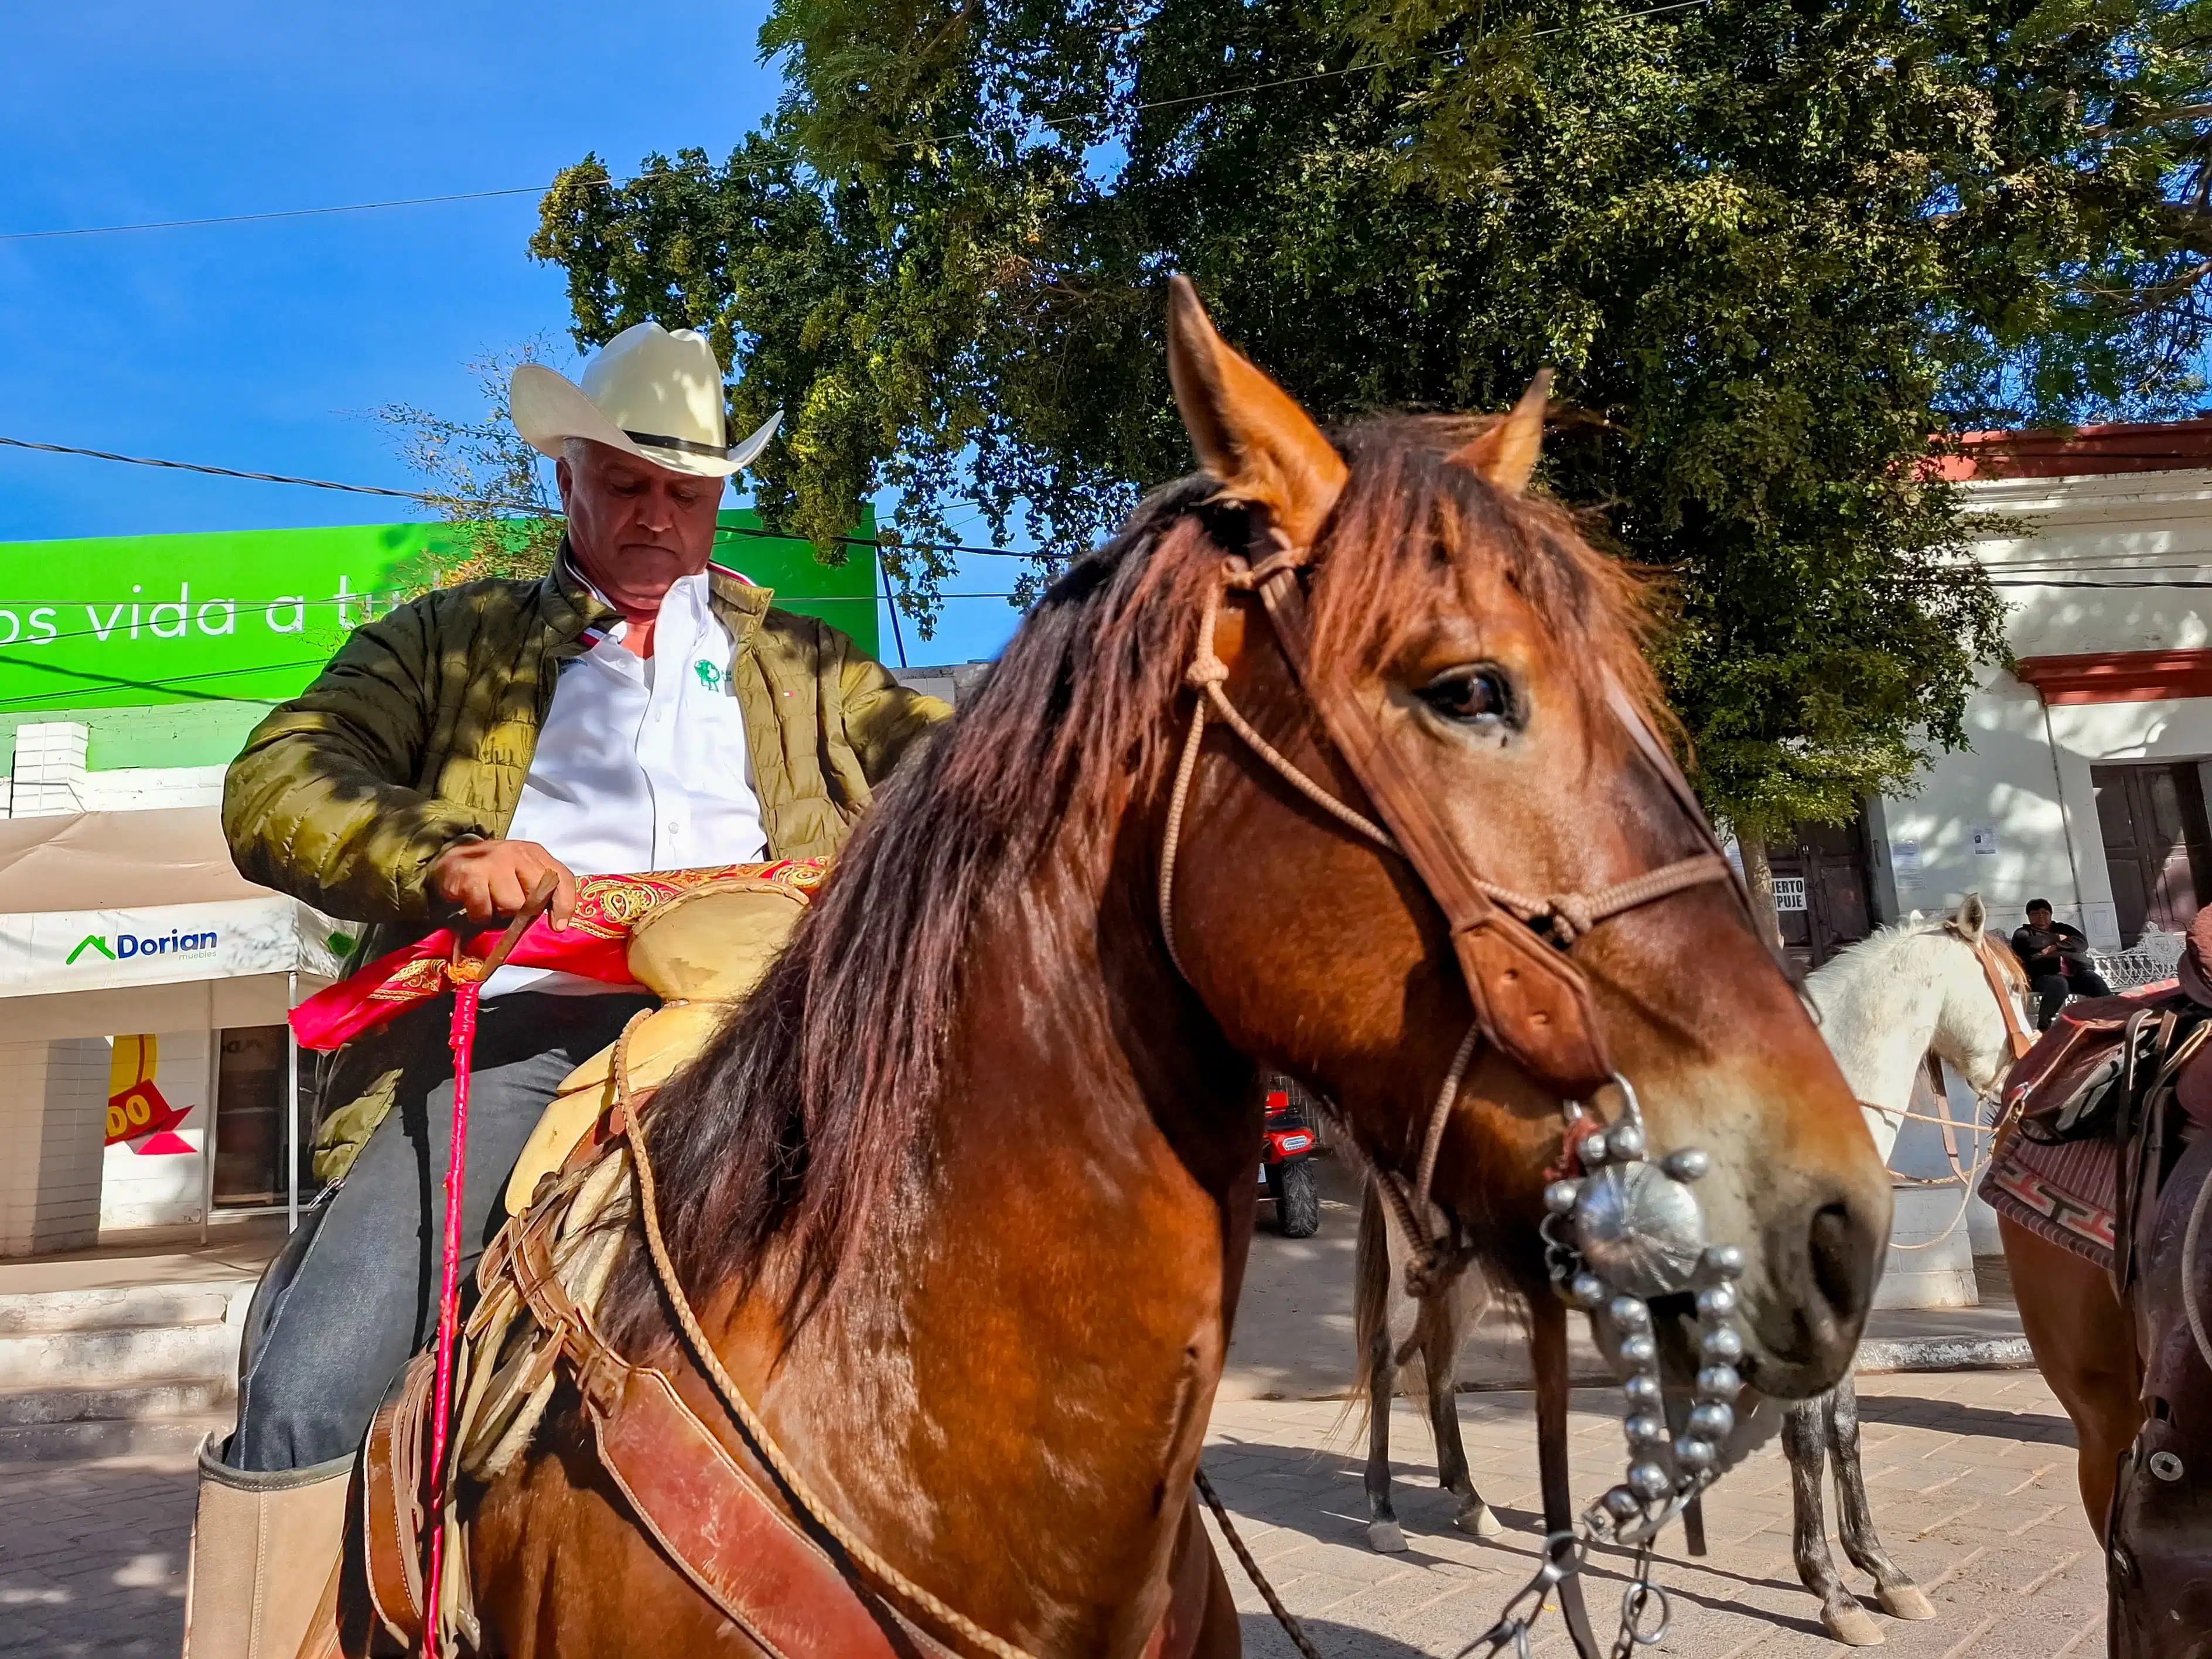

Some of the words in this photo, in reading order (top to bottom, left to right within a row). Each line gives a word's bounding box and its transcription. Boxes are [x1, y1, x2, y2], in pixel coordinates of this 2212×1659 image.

[86, 581, 235, 642] vida
[265, 595, 304, 633] a
[1774, 895, 1803, 908] PUJE
[118, 929, 217, 959] Dorian
[178, 951, 217, 961] muebles
[105, 1094, 151, 1137] DO
